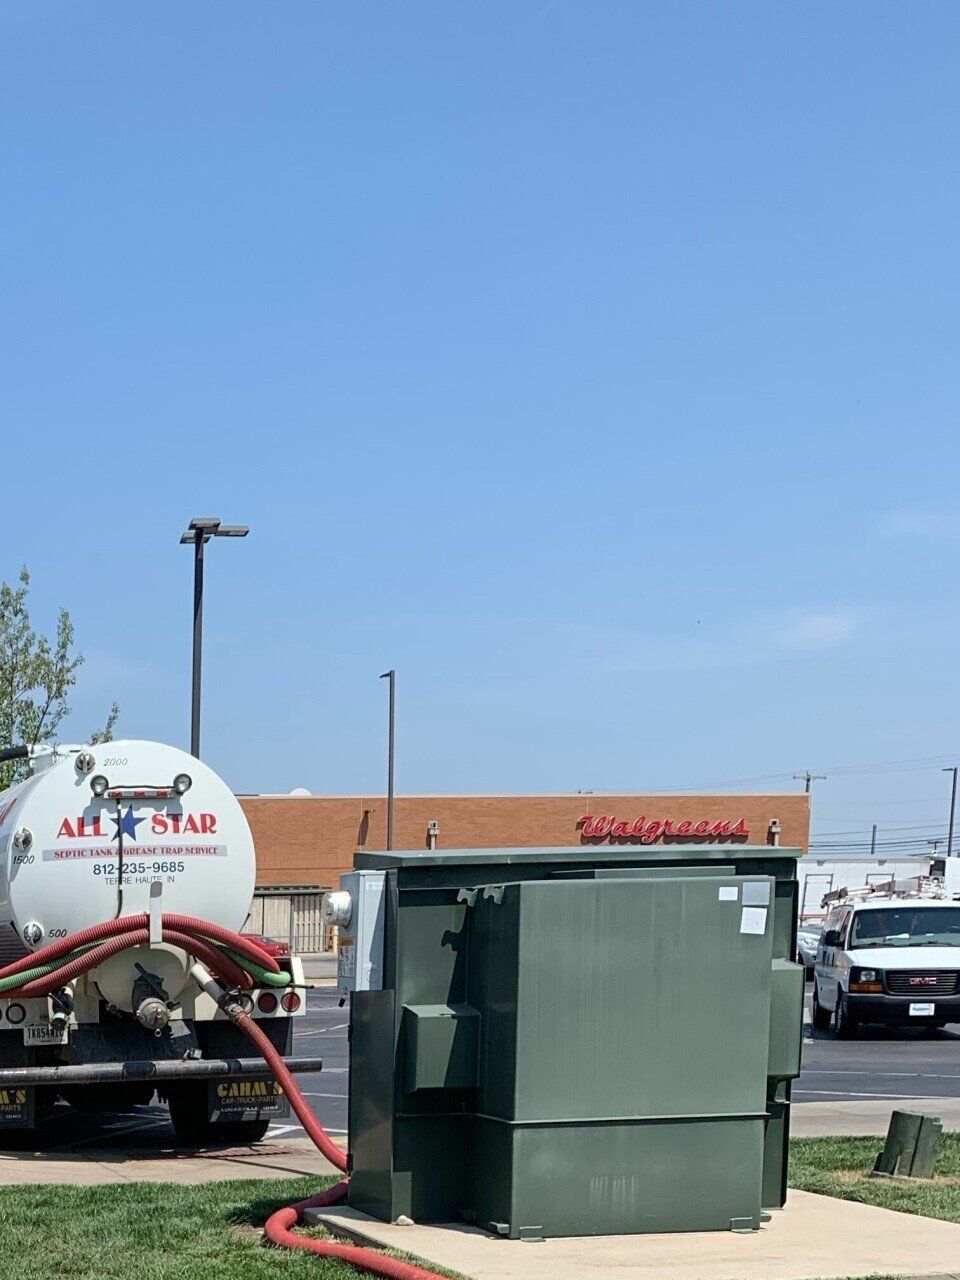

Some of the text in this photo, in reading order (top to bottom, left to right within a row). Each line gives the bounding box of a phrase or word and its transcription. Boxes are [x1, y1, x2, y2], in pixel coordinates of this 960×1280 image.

[103, 758, 128, 767] 2000
[56, 813, 218, 839] ALL STAR
[577, 815, 751, 843] Walgreens
[53, 849, 86, 859] SEPTIC
[90, 849, 114, 857] TANK
[124, 847, 157, 856] GREASE
[160, 847, 183, 855] TRAP
[185, 846, 218, 855] SERVICE
[13, 855, 35, 865] 1500
[93, 862, 185, 875] 812-235-9685
[167, 875, 175, 883] IN
[48, 928, 67, 938] 500
